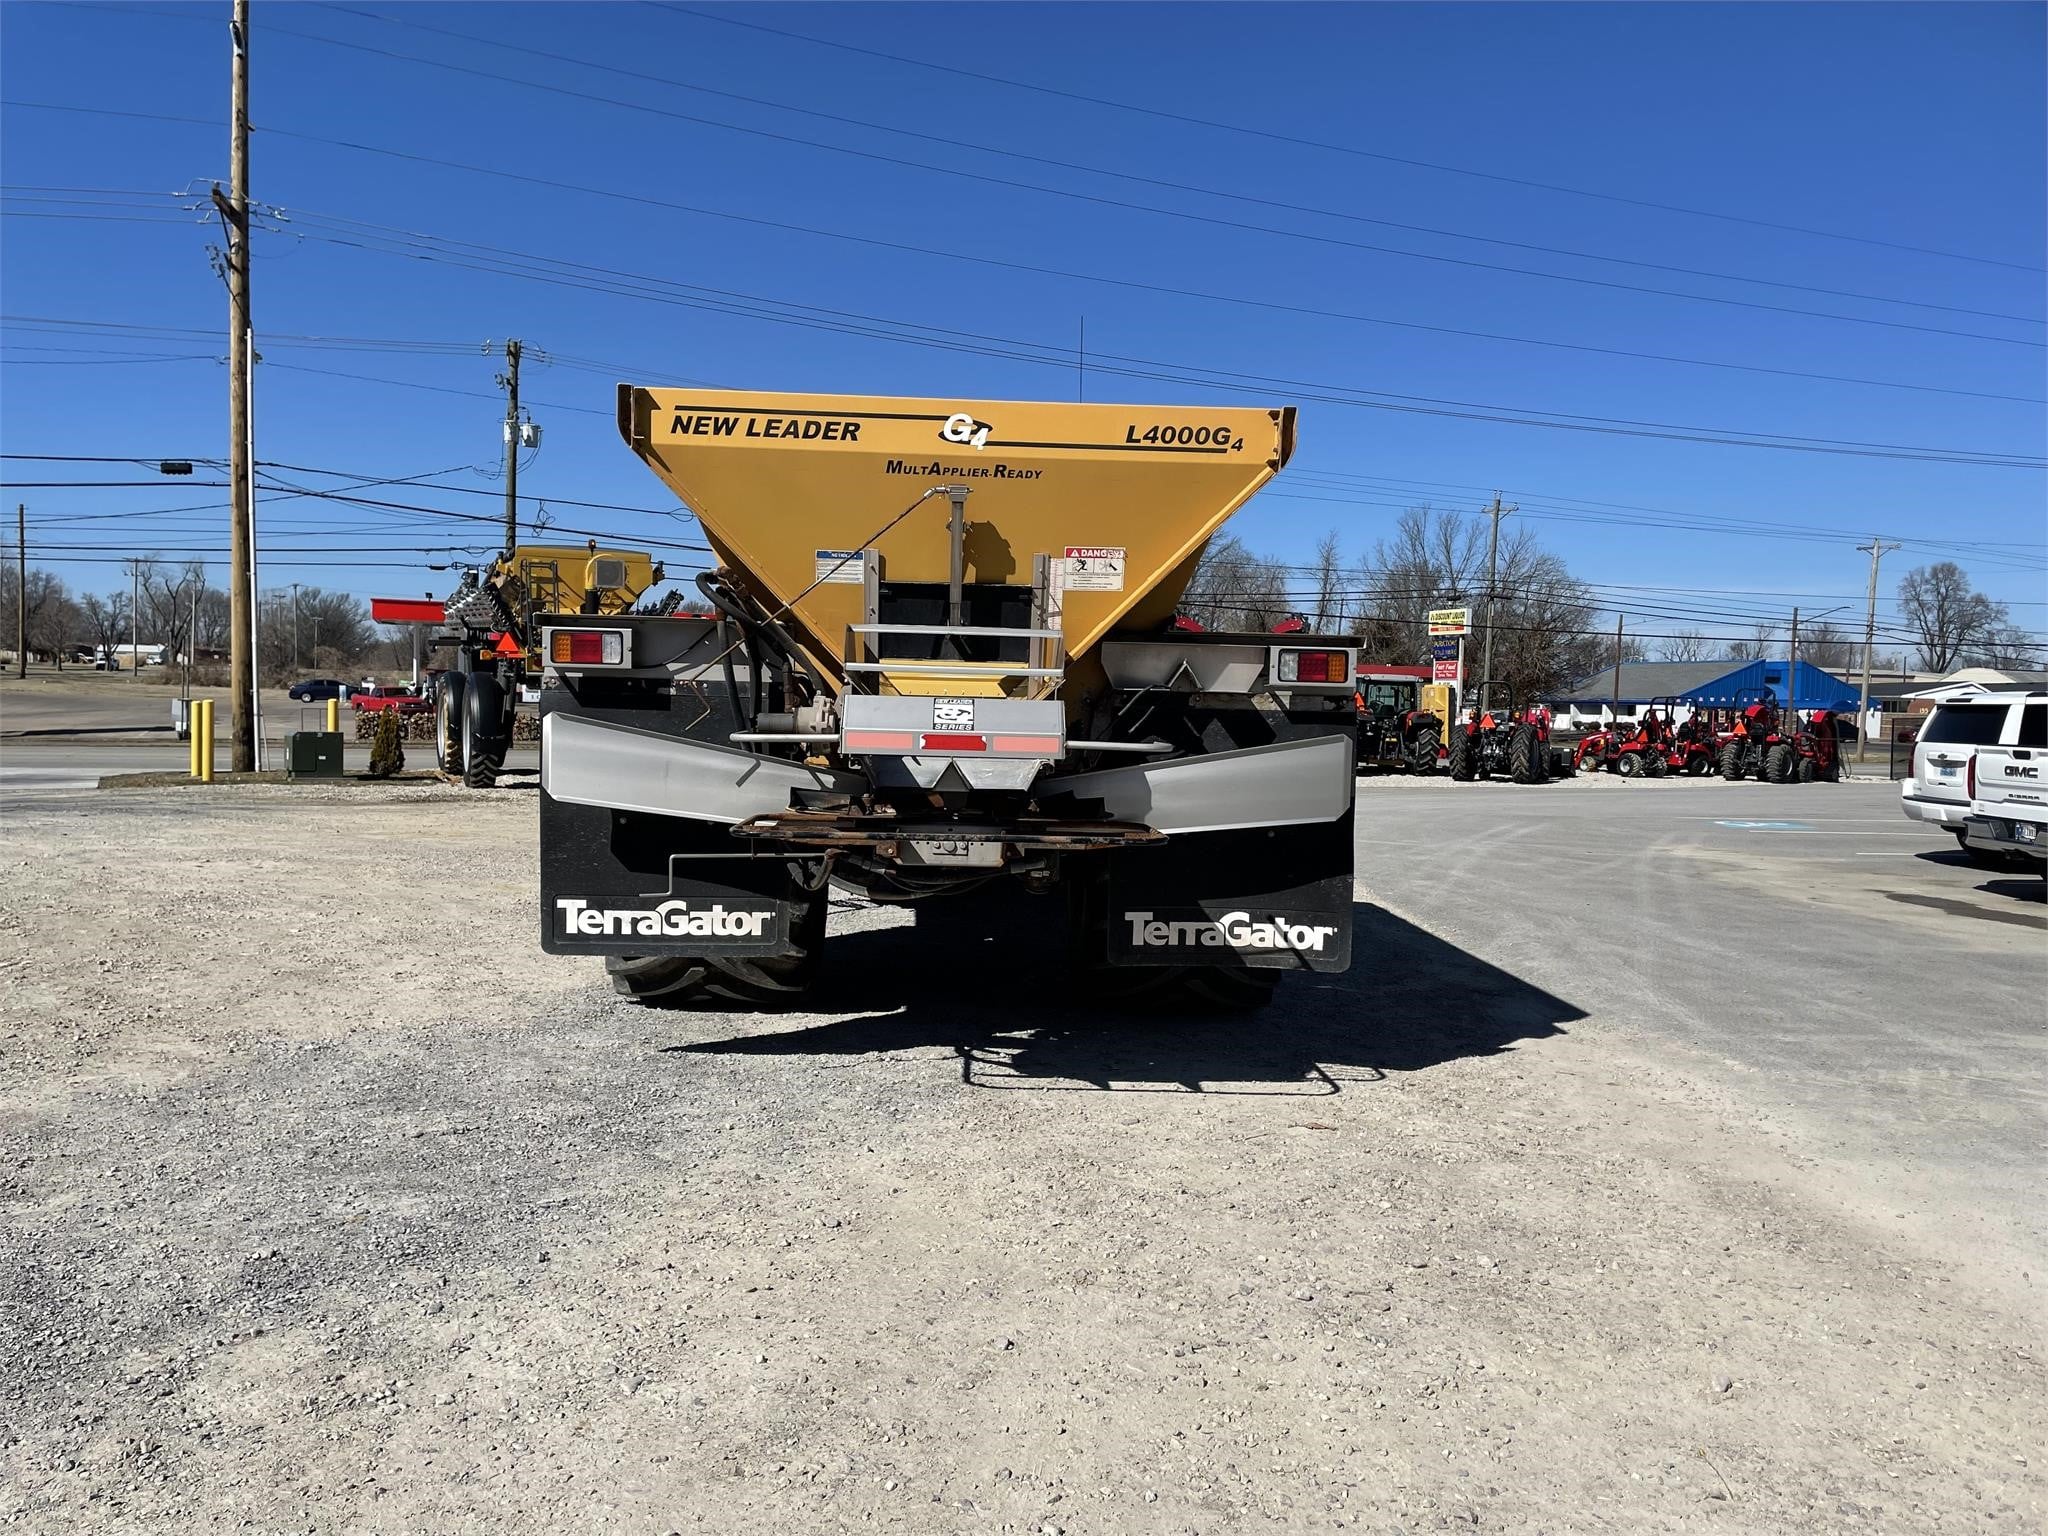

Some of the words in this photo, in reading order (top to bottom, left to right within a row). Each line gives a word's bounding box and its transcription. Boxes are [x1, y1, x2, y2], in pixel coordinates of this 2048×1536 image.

[670, 415, 740, 436] NEW
[745, 418, 861, 441] LEADER
[934, 723, 973, 731] SERIES
[2004, 766, 2039, 779] GMC
[556, 899, 776, 937] TerraGator
[1124, 911, 1338, 951] TerraGator
